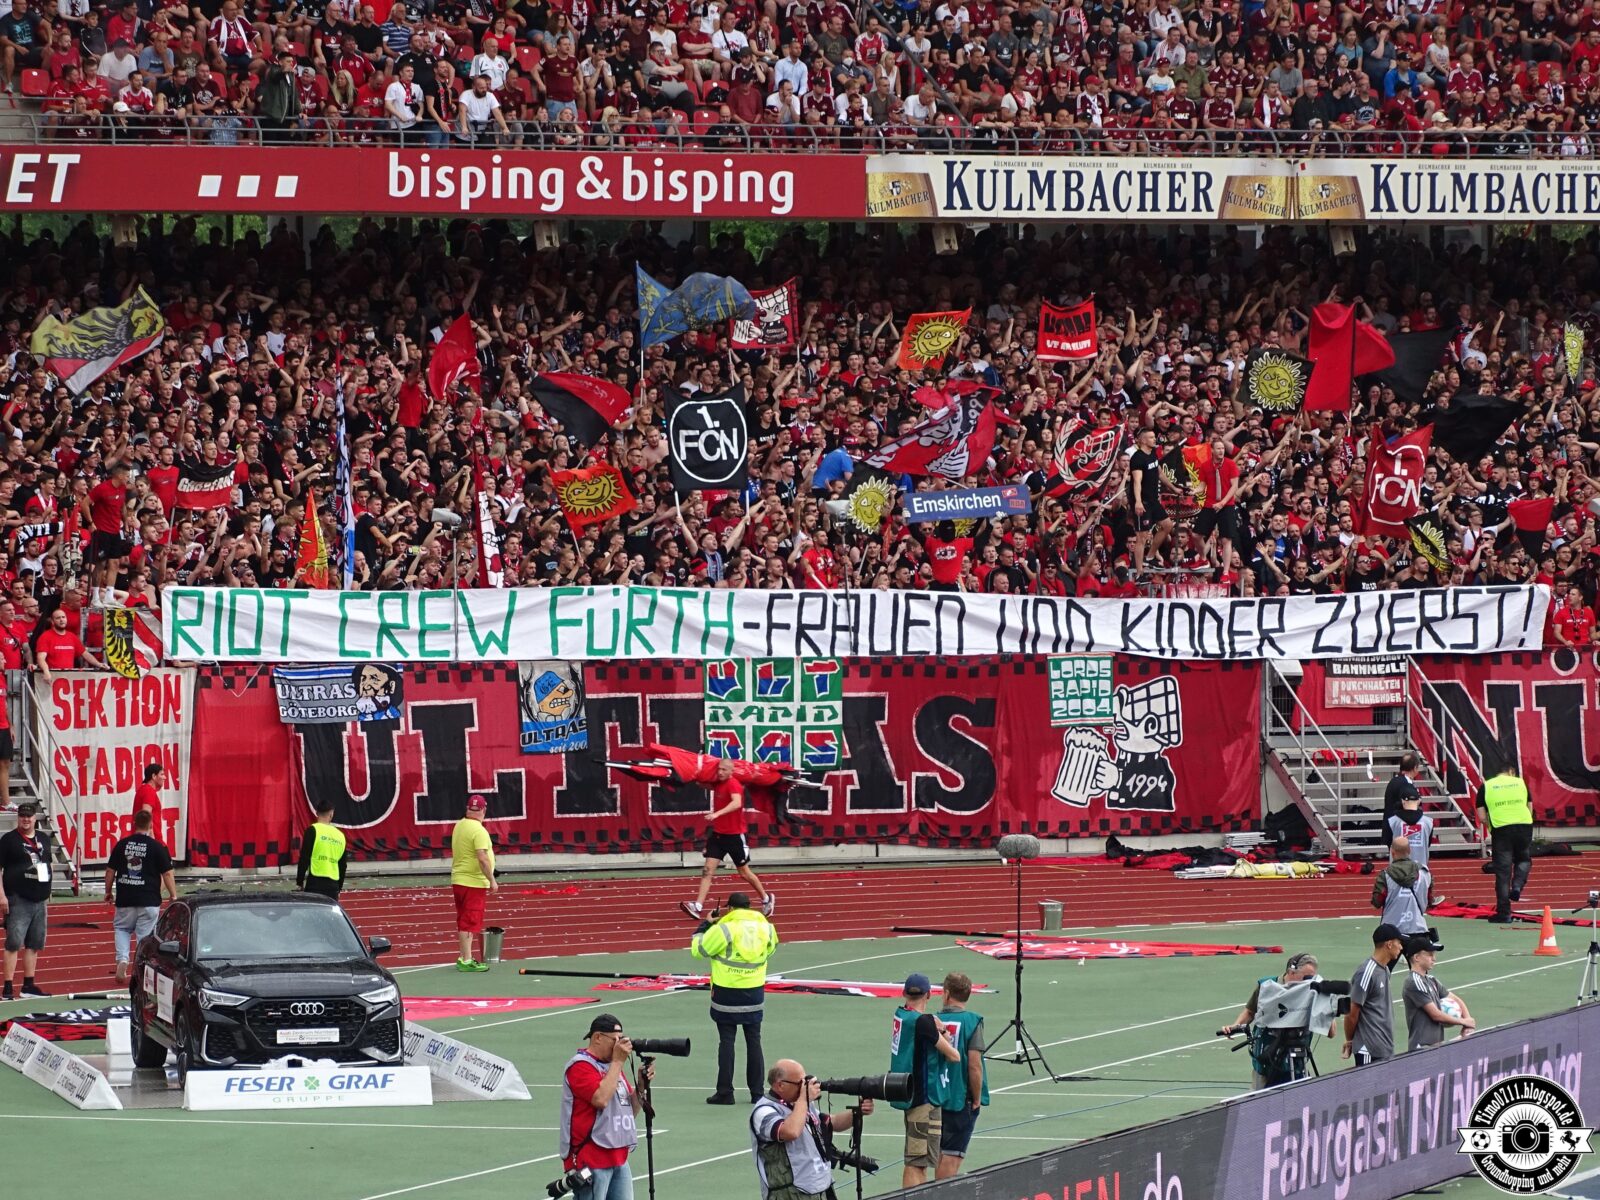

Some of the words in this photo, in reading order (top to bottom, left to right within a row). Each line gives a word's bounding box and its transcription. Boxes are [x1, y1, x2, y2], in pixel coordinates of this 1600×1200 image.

[388, 152, 565, 212] bisping
[576, 155, 612, 200] &
[622, 156, 794, 215] bisping
[943, 160, 1214, 213] KULMBACHER
[867, 191, 930, 215] KULMBACHER
[1226, 191, 1287, 217] KULMBACHER
[1298, 193, 1359, 217] KULMBACHER
[697, 405, 720, 428] 1.
[679, 428, 739, 462] FCN
[1371, 473, 1420, 507] FCN
[912, 493, 1002, 514] Emskirchen
[171, 588, 310, 657] RIOT
[339, 590, 517, 658] CREW
[997, 598, 1094, 655] UND
[1121, 598, 1287, 658] KINDER
[1313, 585, 1533, 655] ZUERST!
[1050, 660, 1113, 680] LORDS
[1332, 662, 1407, 675] BANNMEILE
[52, 673, 181, 731] SEKTION
[276, 682, 357, 700] ULTRAS
[279, 702, 357, 719] GÖTEBORG
[707, 704, 839, 724] RAPID
[1052, 698, 1113, 717] 2004
[519, 718, 588, 748] ULTRAS
[1125, 773, 1169, 799] 1994
[1400, 910, 1414, 923] 29
[225, 1076, 296, 1093] FESER
[328, 1073, 395, 1091] GRAF
[272, 1095, 345, 1104] GRUPPE
[1262, 1089, 1399, 1200] Fahrgast
[1408, 1072, 1445, 1156] TV
